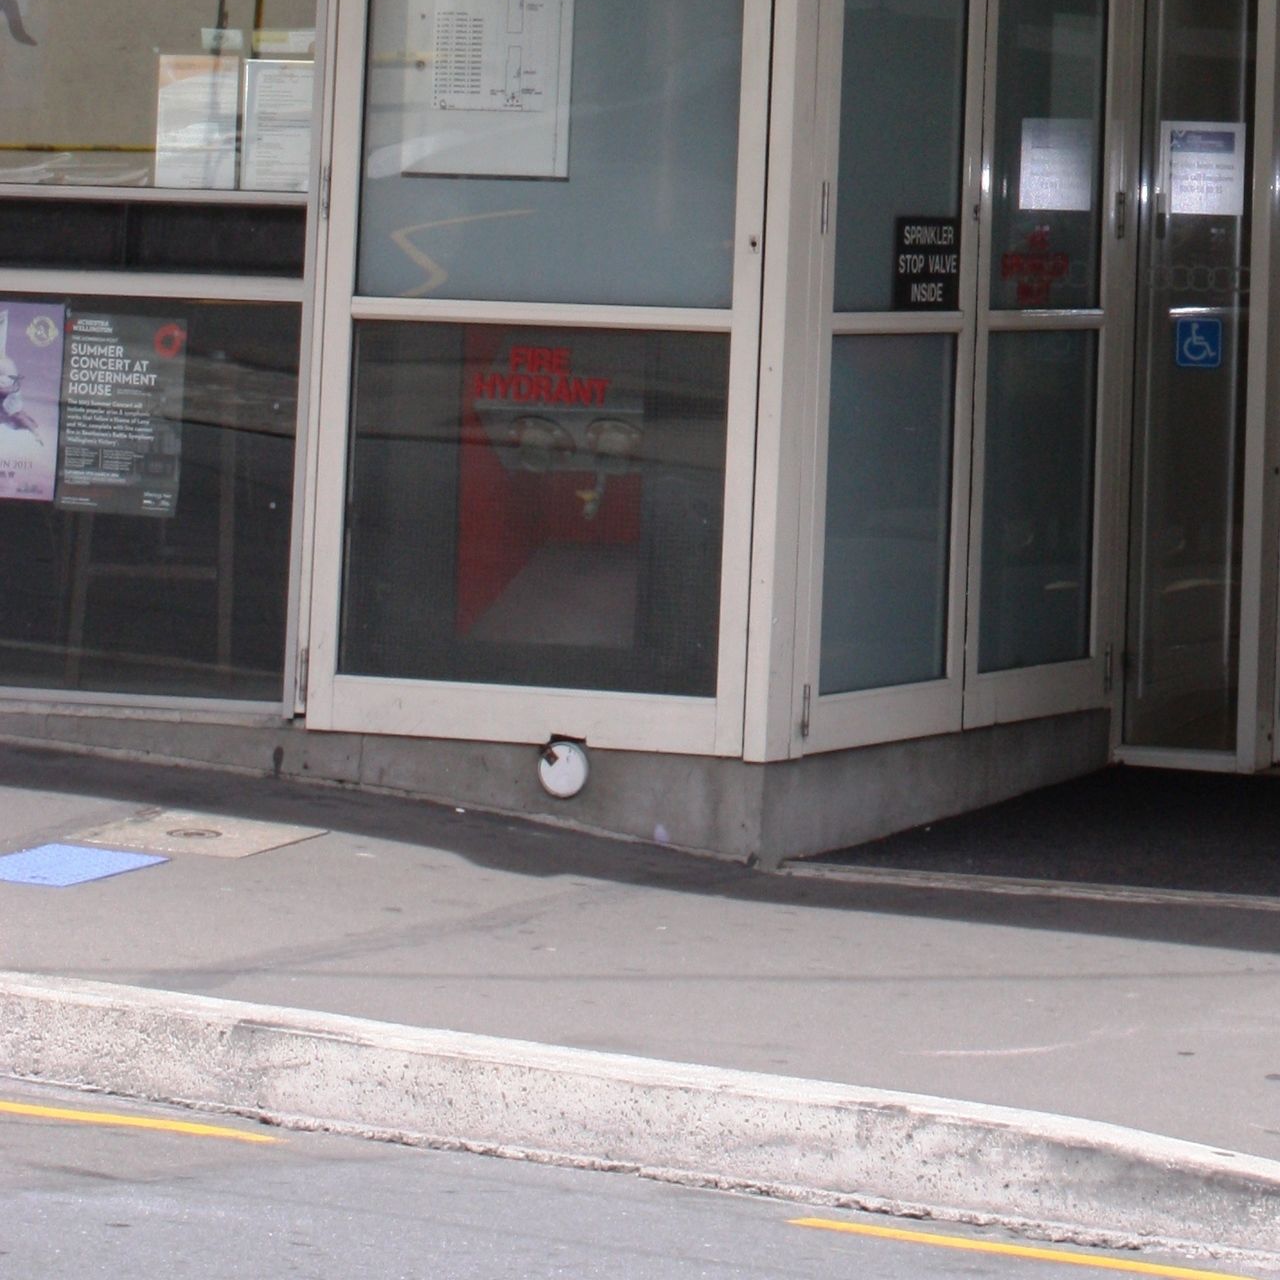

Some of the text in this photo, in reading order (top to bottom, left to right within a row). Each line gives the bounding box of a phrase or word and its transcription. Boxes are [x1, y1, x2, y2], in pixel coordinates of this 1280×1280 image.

[903, 225, 955, 246] SPRINKLER
[898, 253, 958, 274] STOP VALVE
[911, 282, 944, 303] INSIDE
[71, 343, 124, 357] SUMMER
[510, 344, 574, 375] FIRE
[71, 356, 149, 372] CONCERT AT
[70, 369, 157, 386] GOVERNMENT
[68, 382, 112, 396] HOUSE
[472, 371, 611, 409] HYDRANT
